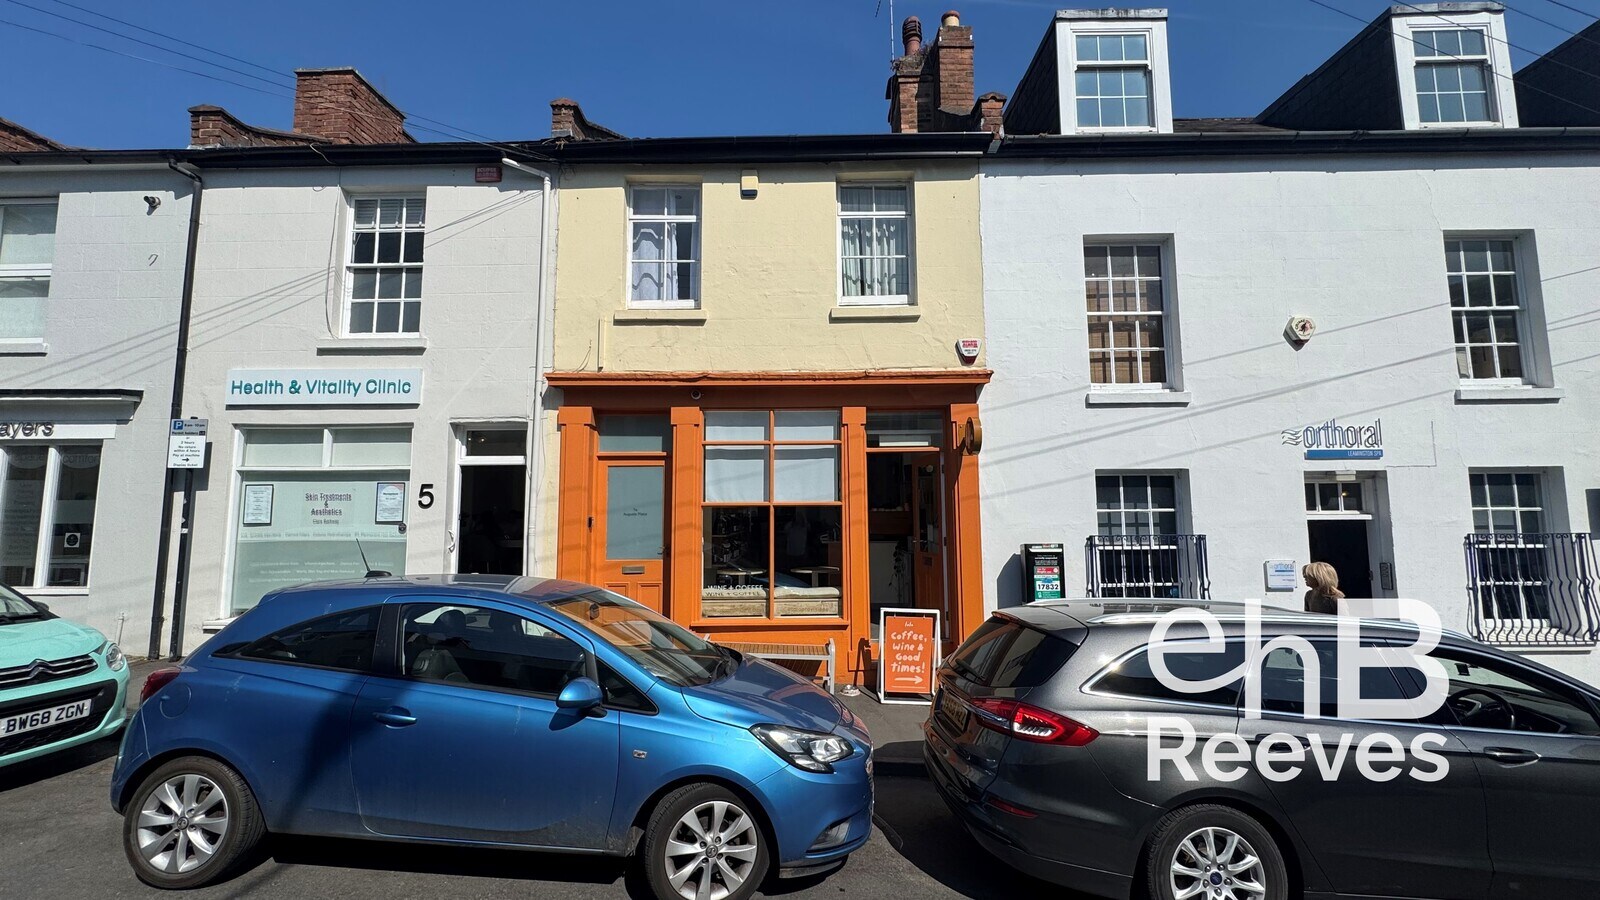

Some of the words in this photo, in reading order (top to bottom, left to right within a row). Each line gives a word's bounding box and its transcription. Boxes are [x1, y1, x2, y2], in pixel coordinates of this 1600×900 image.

[231, 380, 284, 395] Health
[288, 380, 301, 394] &
[306, 379, 362, 398] Vitality
[366, 379, 412, 394] Clinic
[1304, 418, 1382, 448] orthoral
[418, 484, 434, 509] 5
[891, 630, 928, 642] Coffee,
[896, 652, 920, 662] Good
[5, 710, 51, 733] BW68
[55, 703, 84, 721] ZGN
